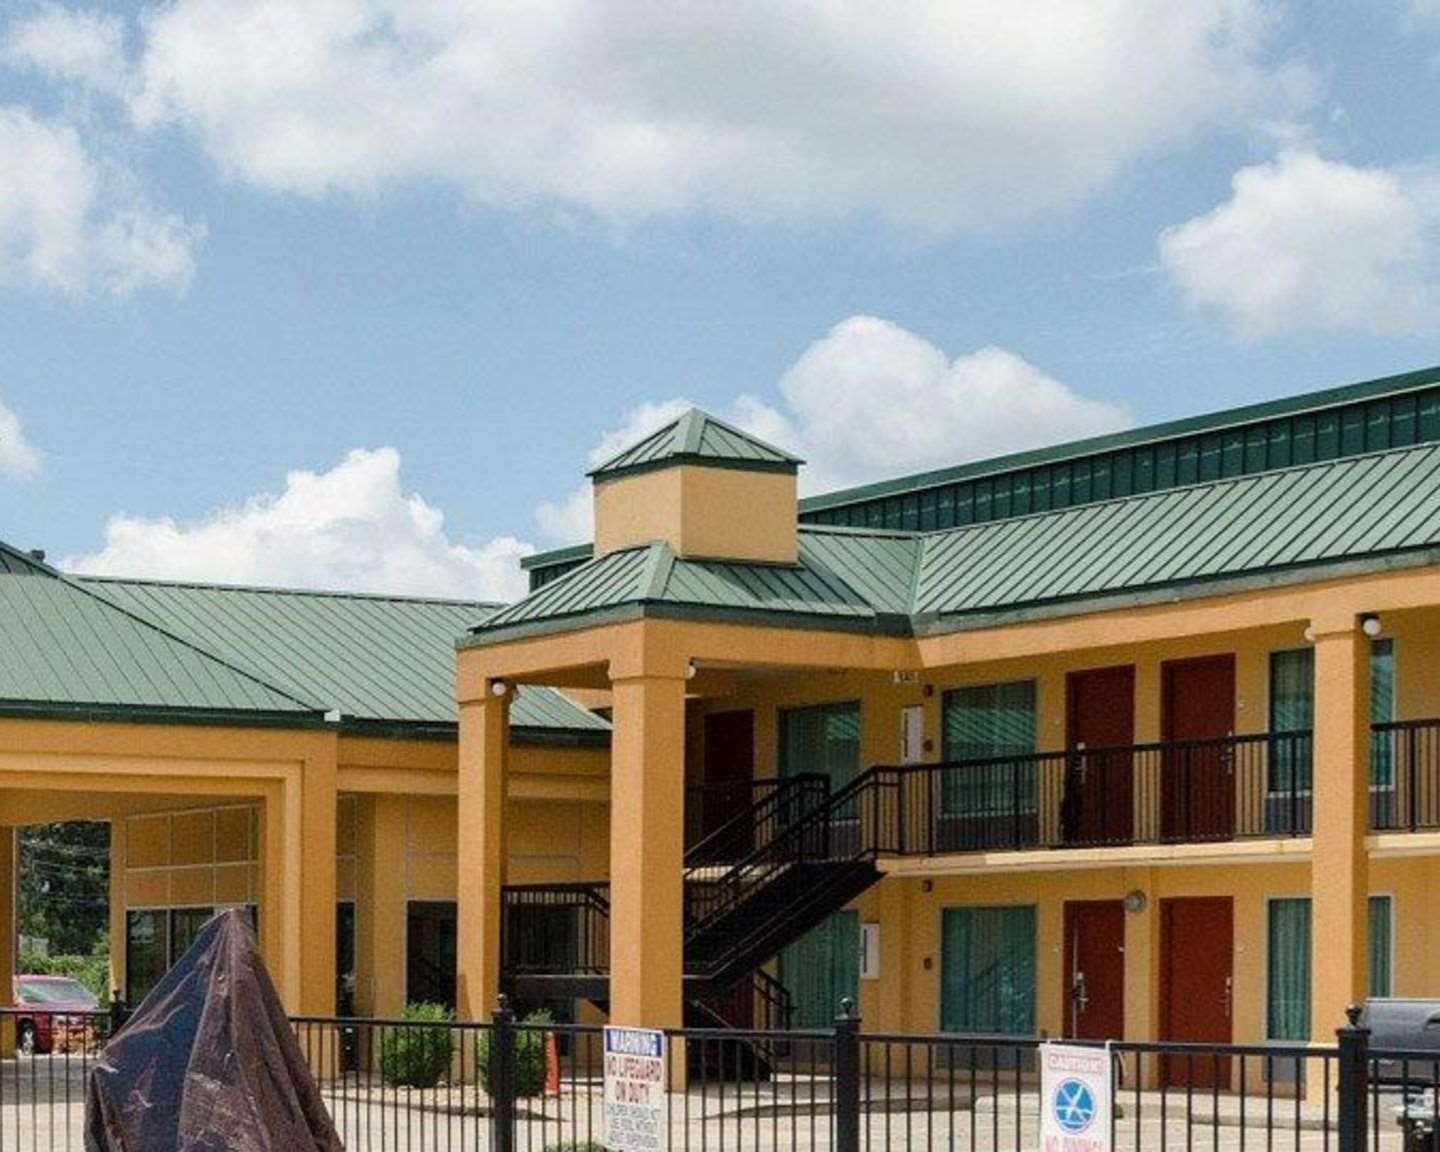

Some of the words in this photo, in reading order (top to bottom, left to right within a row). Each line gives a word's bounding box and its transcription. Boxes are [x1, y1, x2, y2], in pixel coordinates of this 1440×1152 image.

[609, 1029, 658, 1055] WARNING
[607, 1056, 617, 1077] NO
[619, 1057, 662, 1082] LIFEGUARD
[616, 1080, 627, 1102] ON
[629, 1081, 650, 1105] DUTY
